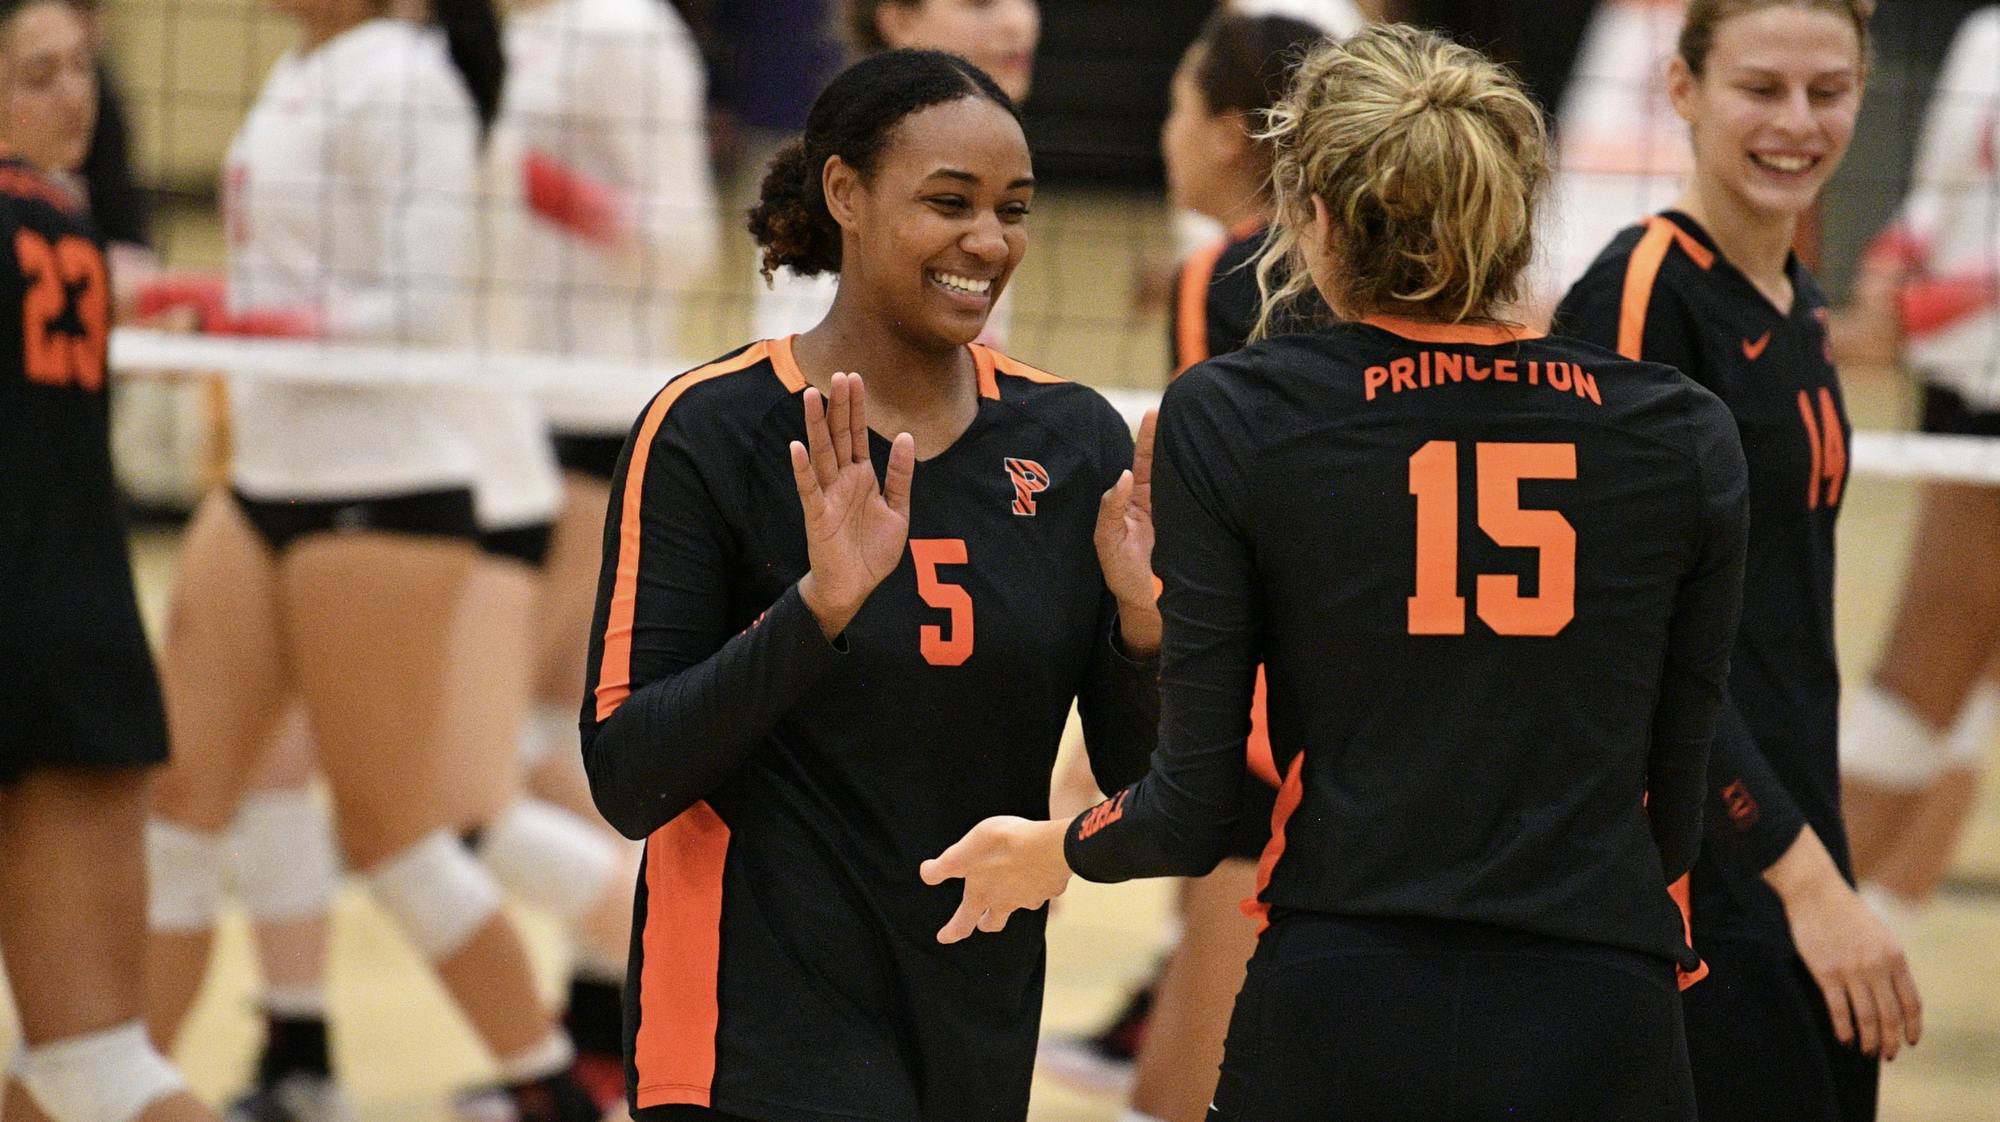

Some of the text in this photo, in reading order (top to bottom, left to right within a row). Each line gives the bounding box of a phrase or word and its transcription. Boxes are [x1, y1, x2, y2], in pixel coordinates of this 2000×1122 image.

[14, 228, 109, 391] 23
[1003, 457, 1051, 517] P
[1797, 387, 1847, 510] 14
[908, 538, 975, 667] 5
[1407, 440, 1578, 637] 15
